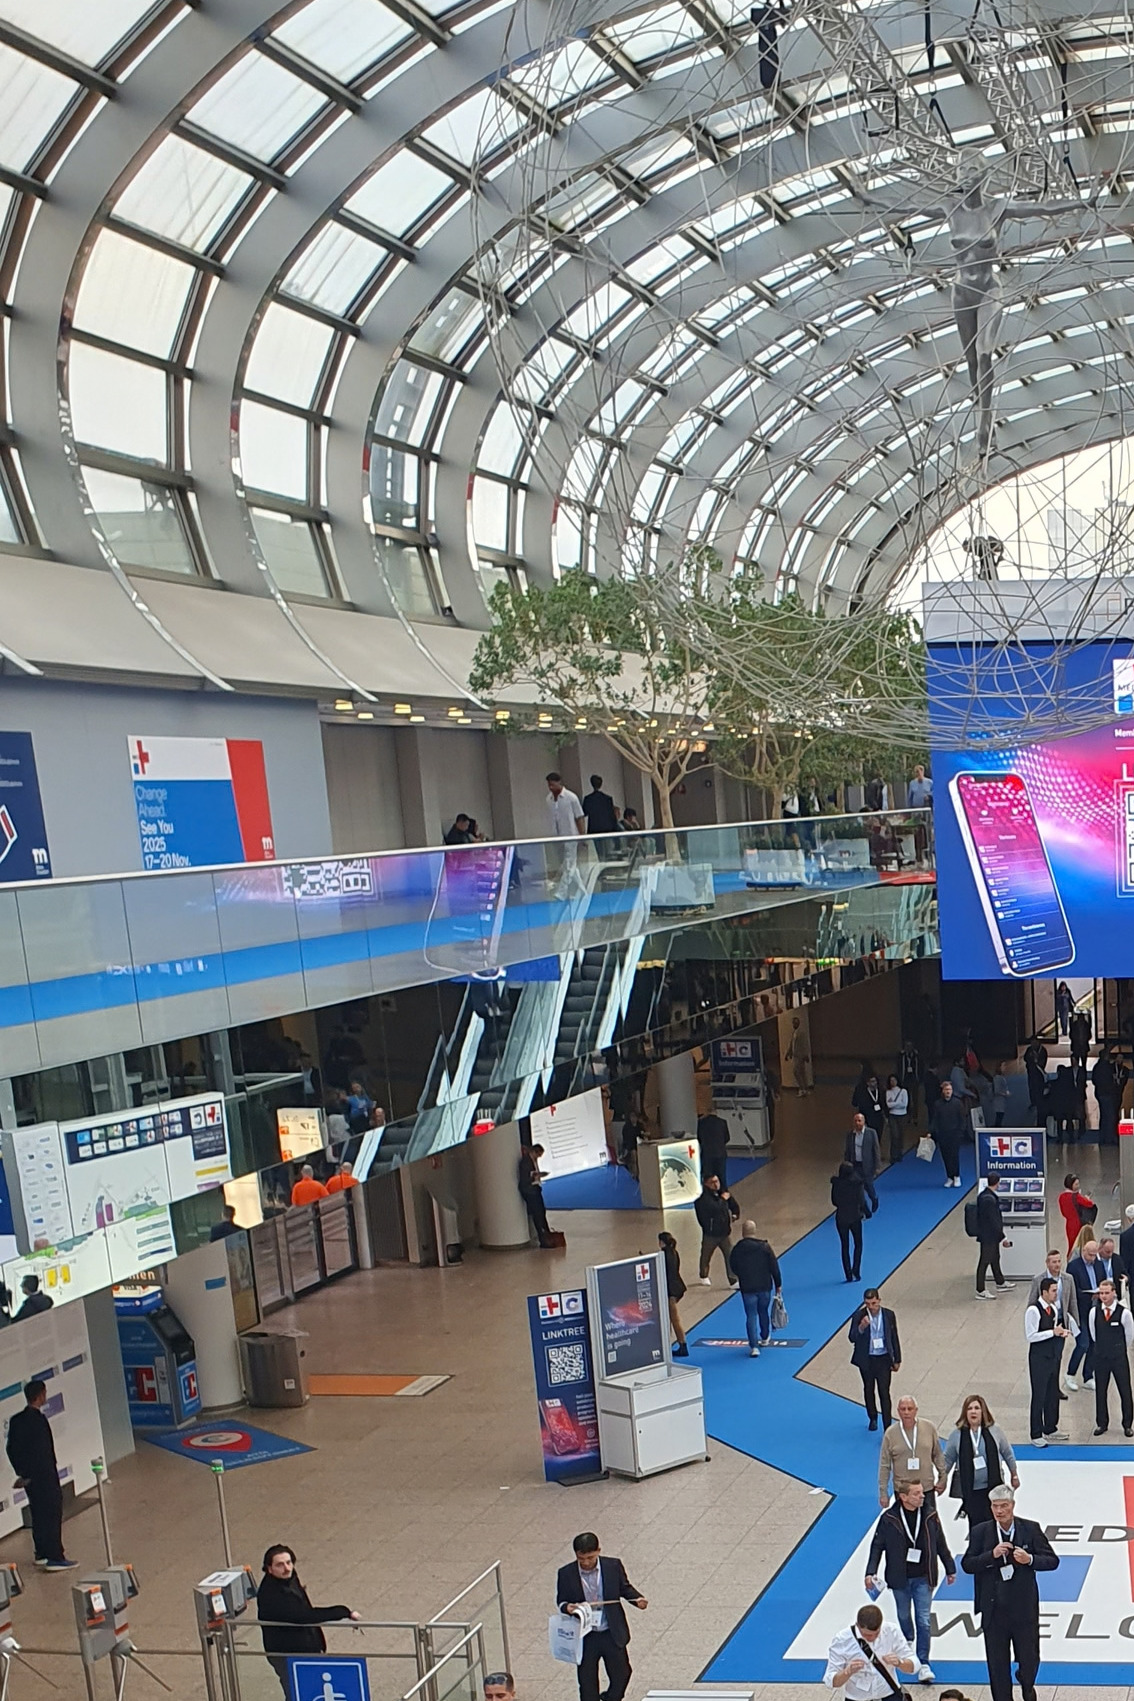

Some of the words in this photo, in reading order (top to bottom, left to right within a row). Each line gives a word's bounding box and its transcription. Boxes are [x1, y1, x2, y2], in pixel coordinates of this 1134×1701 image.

[135, 785, 168, 803] Change
[140, 820, 158, 835] See
[157, 819, 175, 834] You
[142, 836, 167, 853] 2025
[172, 852, 192, 867] Nov.
[986, 1160, 1037, 1170] Information
[541, 1326, 586, 1341] LINKTREE
